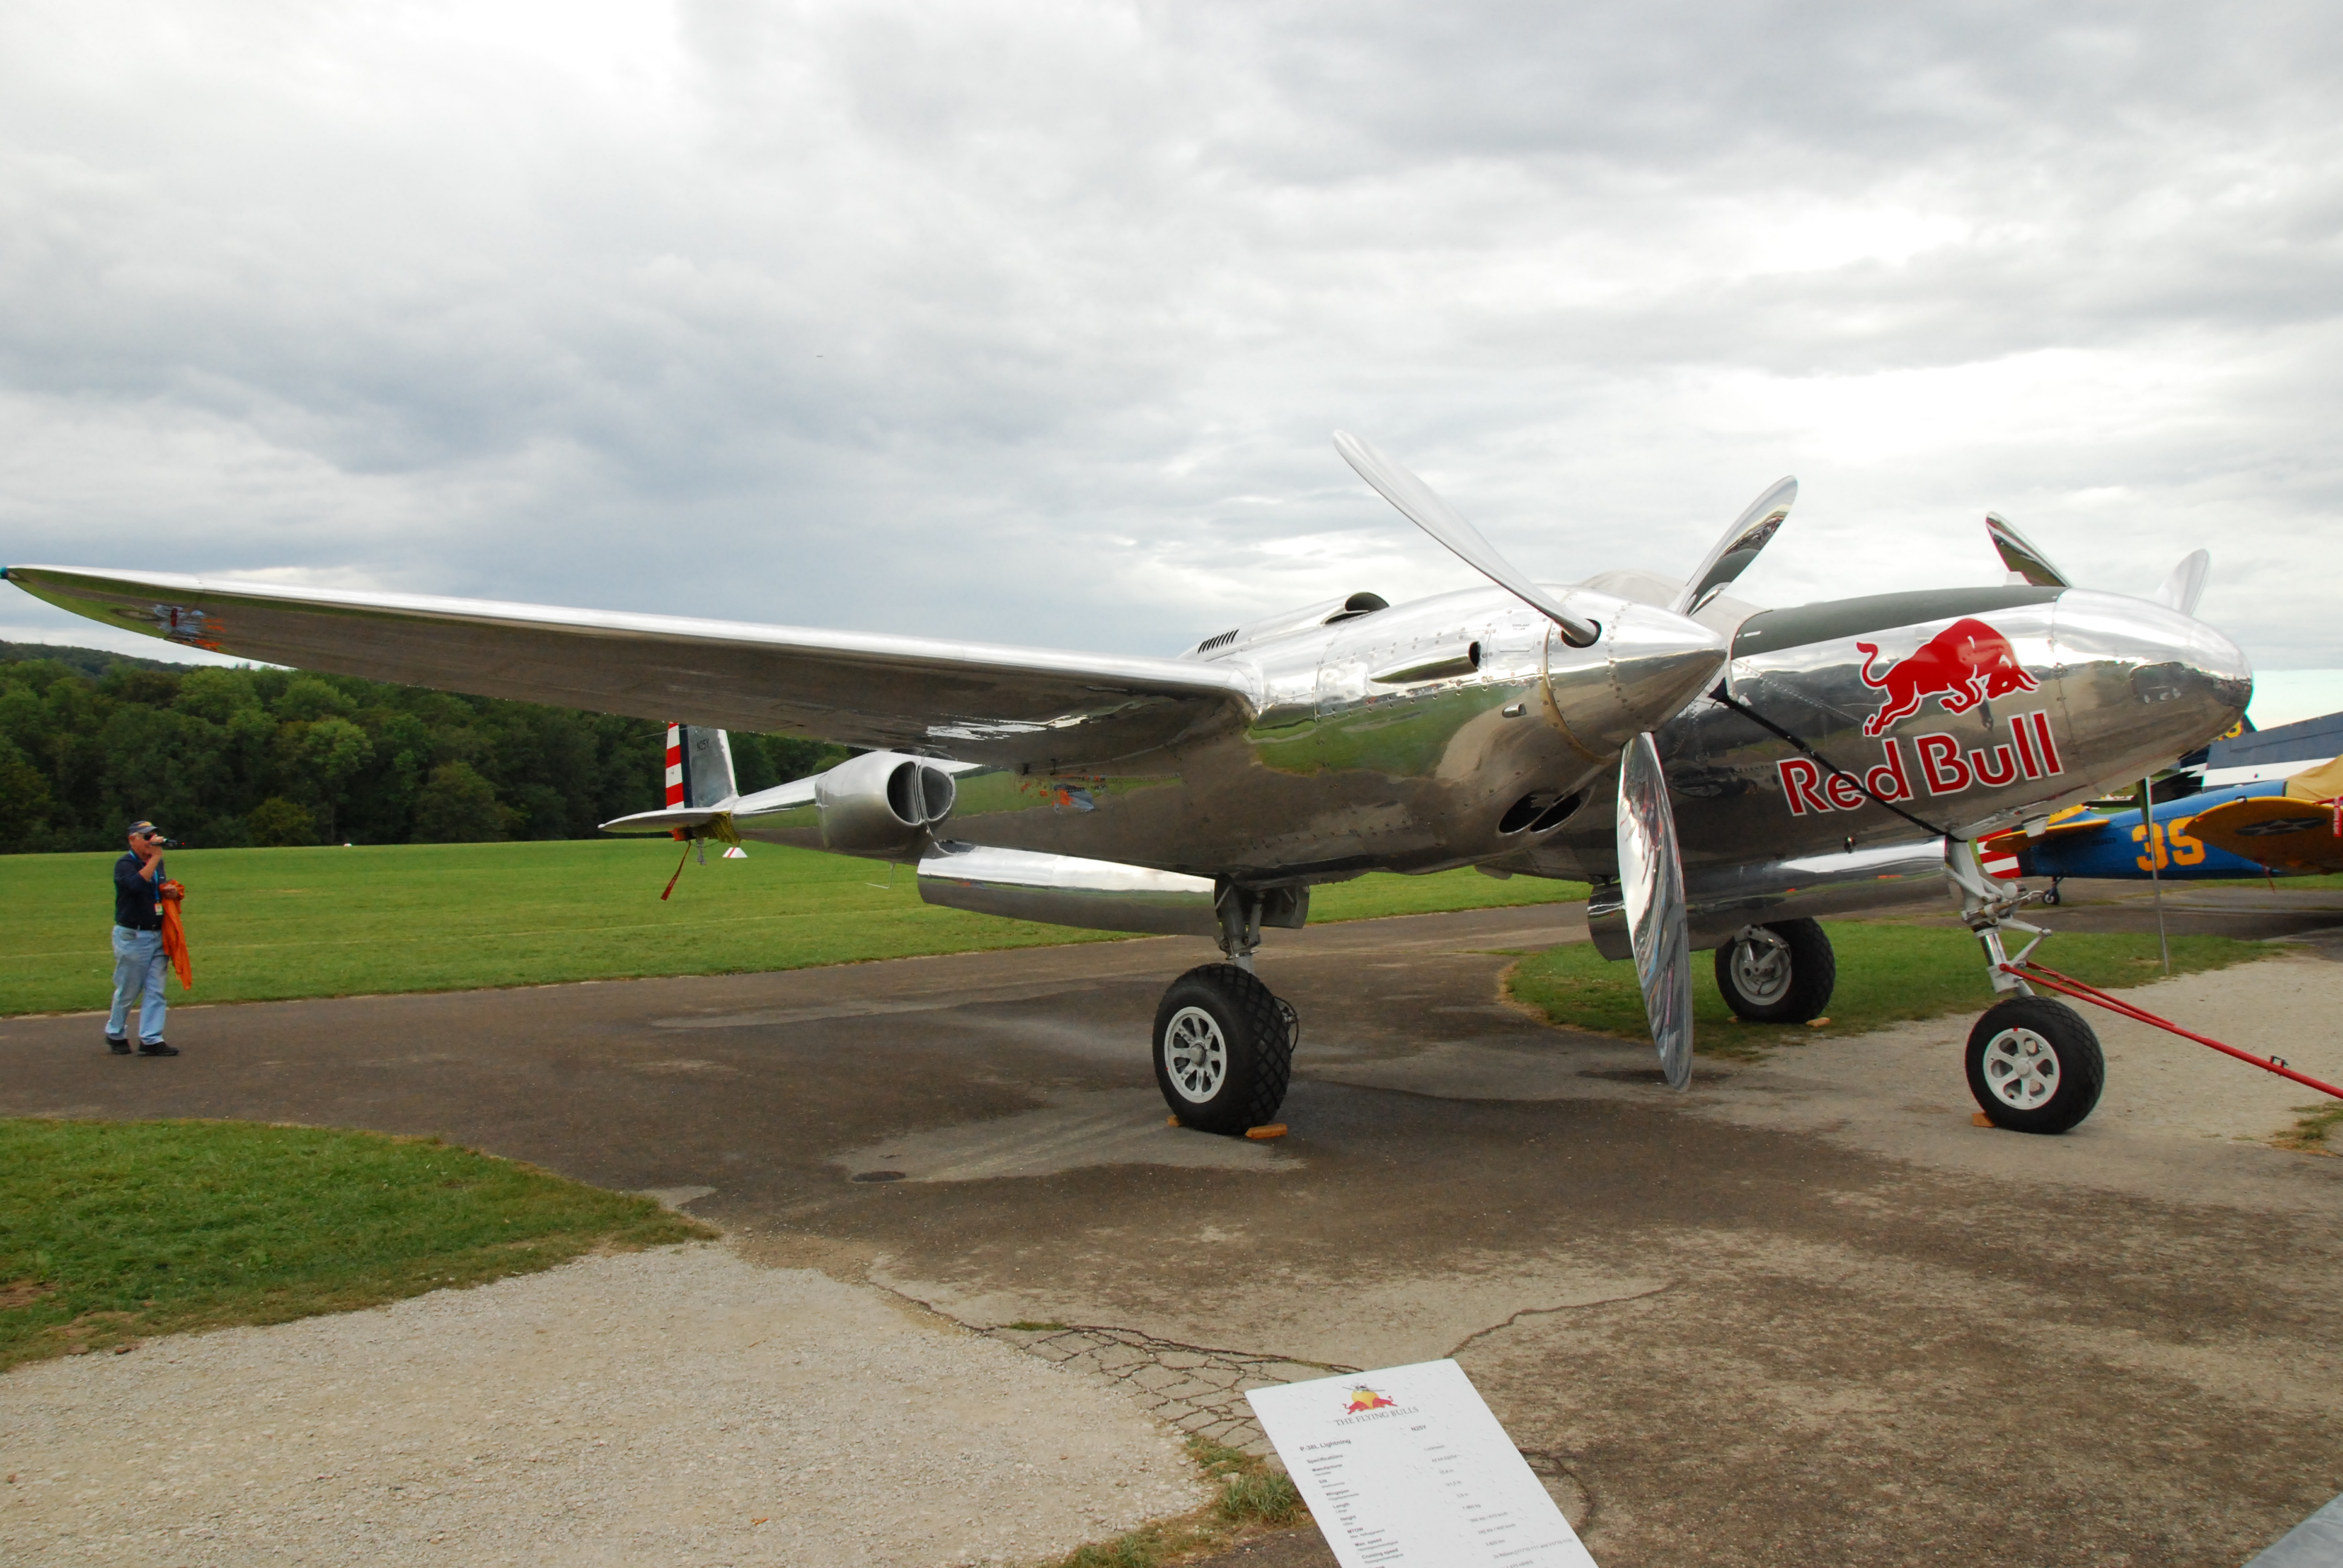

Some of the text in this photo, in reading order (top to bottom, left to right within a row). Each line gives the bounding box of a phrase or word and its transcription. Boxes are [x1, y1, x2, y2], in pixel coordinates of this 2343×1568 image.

[696, 737, 710, 751] N25Y
[1776, 709, 2064, 817] Red Bull
[2131, 816, 2206, 871] 35
[1356, 1411, 1389, 1423] FLYING
[1391, 1406, 1419, 1416] BULLS
[1320, 1439, 1351, 1448] Lightning
[1307, 1455, 1343, 1463] Specifications
